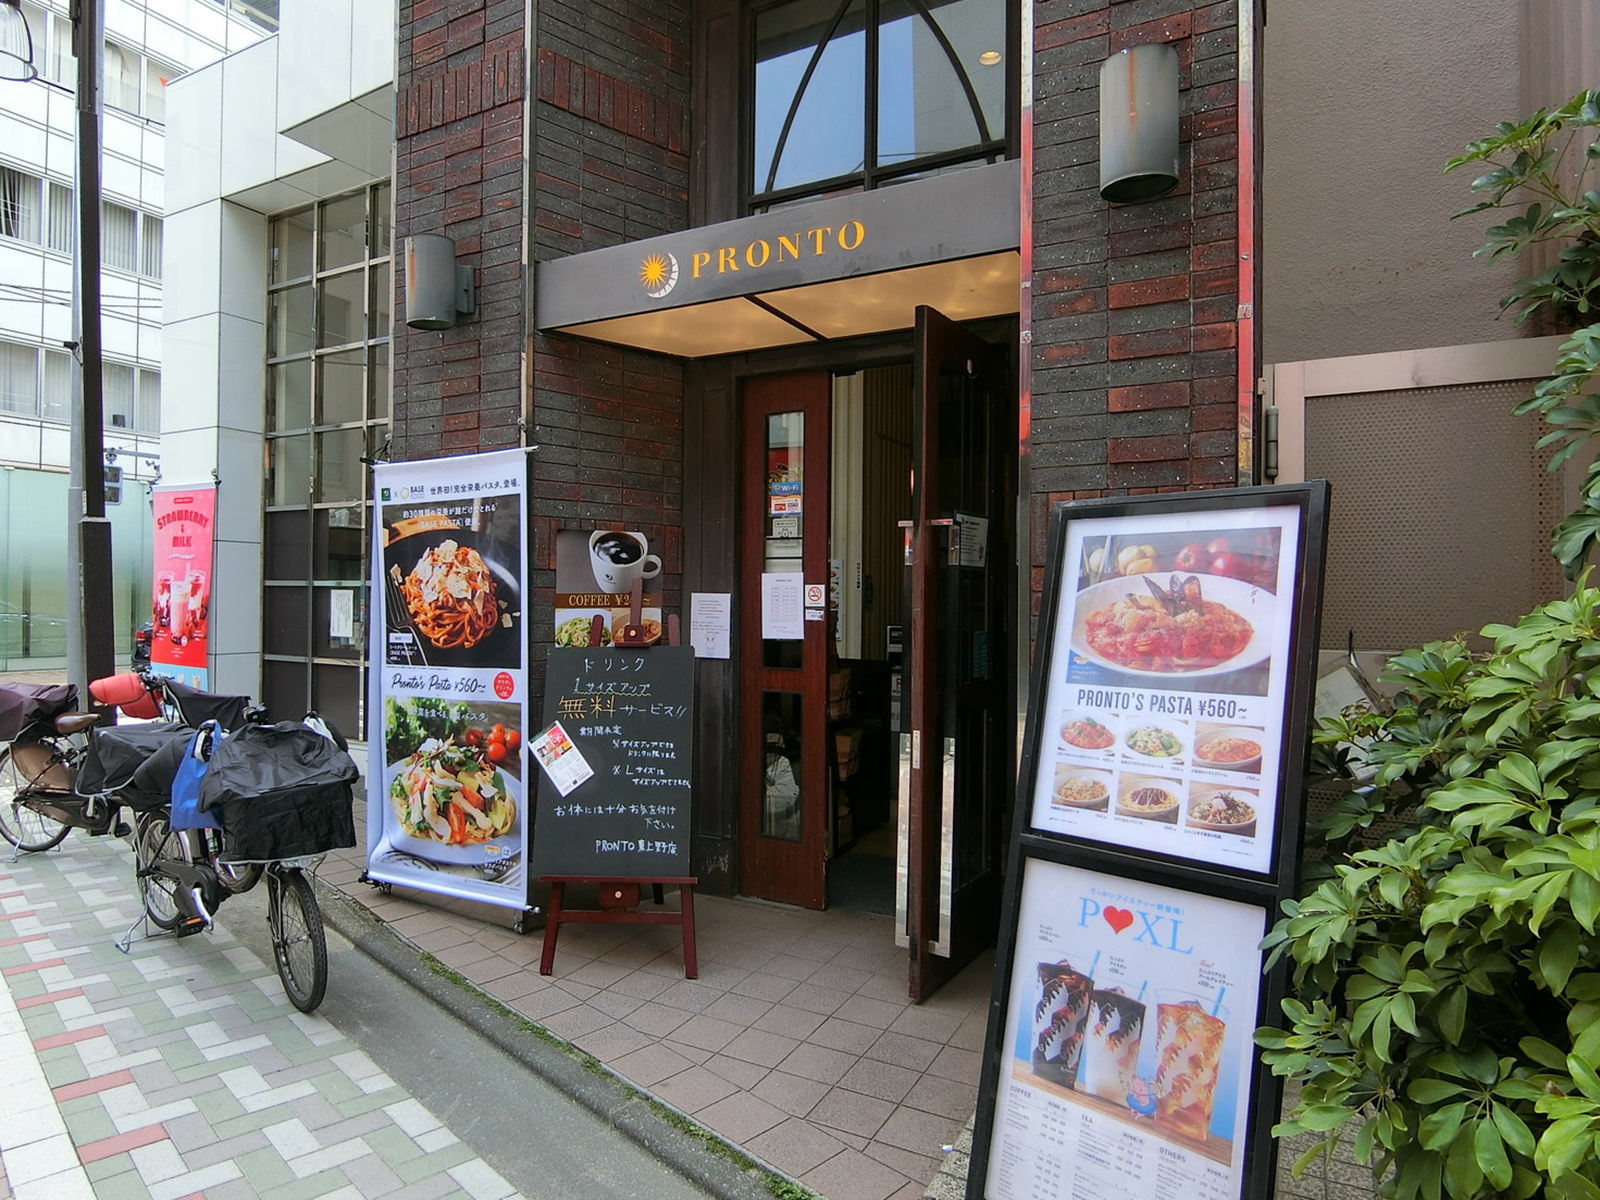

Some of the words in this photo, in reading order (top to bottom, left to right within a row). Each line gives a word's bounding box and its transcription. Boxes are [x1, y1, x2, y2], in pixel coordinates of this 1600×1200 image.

[691, 219, 866, 279] PRONTO
[410, 485, 425, 493] BASE
[781, 484, 800, 492] Wi-Fi
[157, 509, 209, 530] STRAWBERRY
[172, 535, 192, 548] MILK
[569, 594, 611, 606] COFFEE
[584, 658, 645, 674] ドリンク
[391, 672, 426, 690] Pronto's
[428, 674, 452, 691] Pasta
[1077, 689, 1145, 711] PRONTO'S
[1149, 694, 1193, 715] PASTA
[579, 725, 622, 737] 期間未定
[1010, 1085, 1032, 1099] COFFEE
[1080, 1113, 1094, 1125] TEA
[1159, 1146, 1187, 1163] OTHERS
